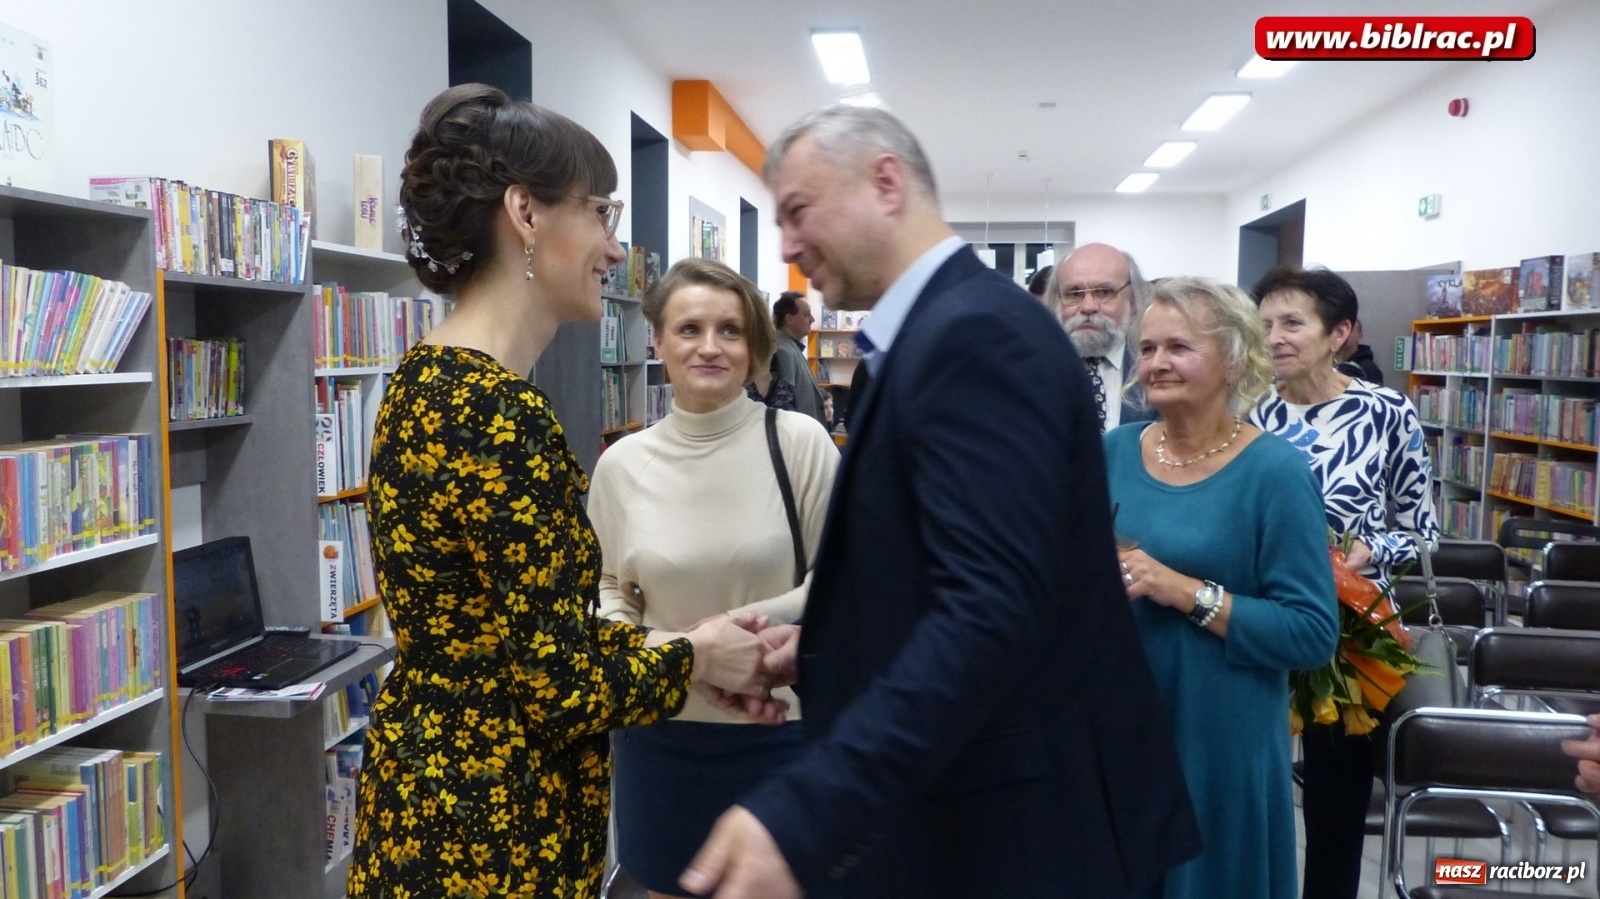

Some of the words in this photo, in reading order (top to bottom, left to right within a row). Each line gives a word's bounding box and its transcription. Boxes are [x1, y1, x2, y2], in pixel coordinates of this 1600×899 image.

[286, 148, 298, 206] CYWILIZAC
[317, 443, 325, 494] CZŁOWIEK
[329, 564, 338, 619] ZWIERZĘTA
